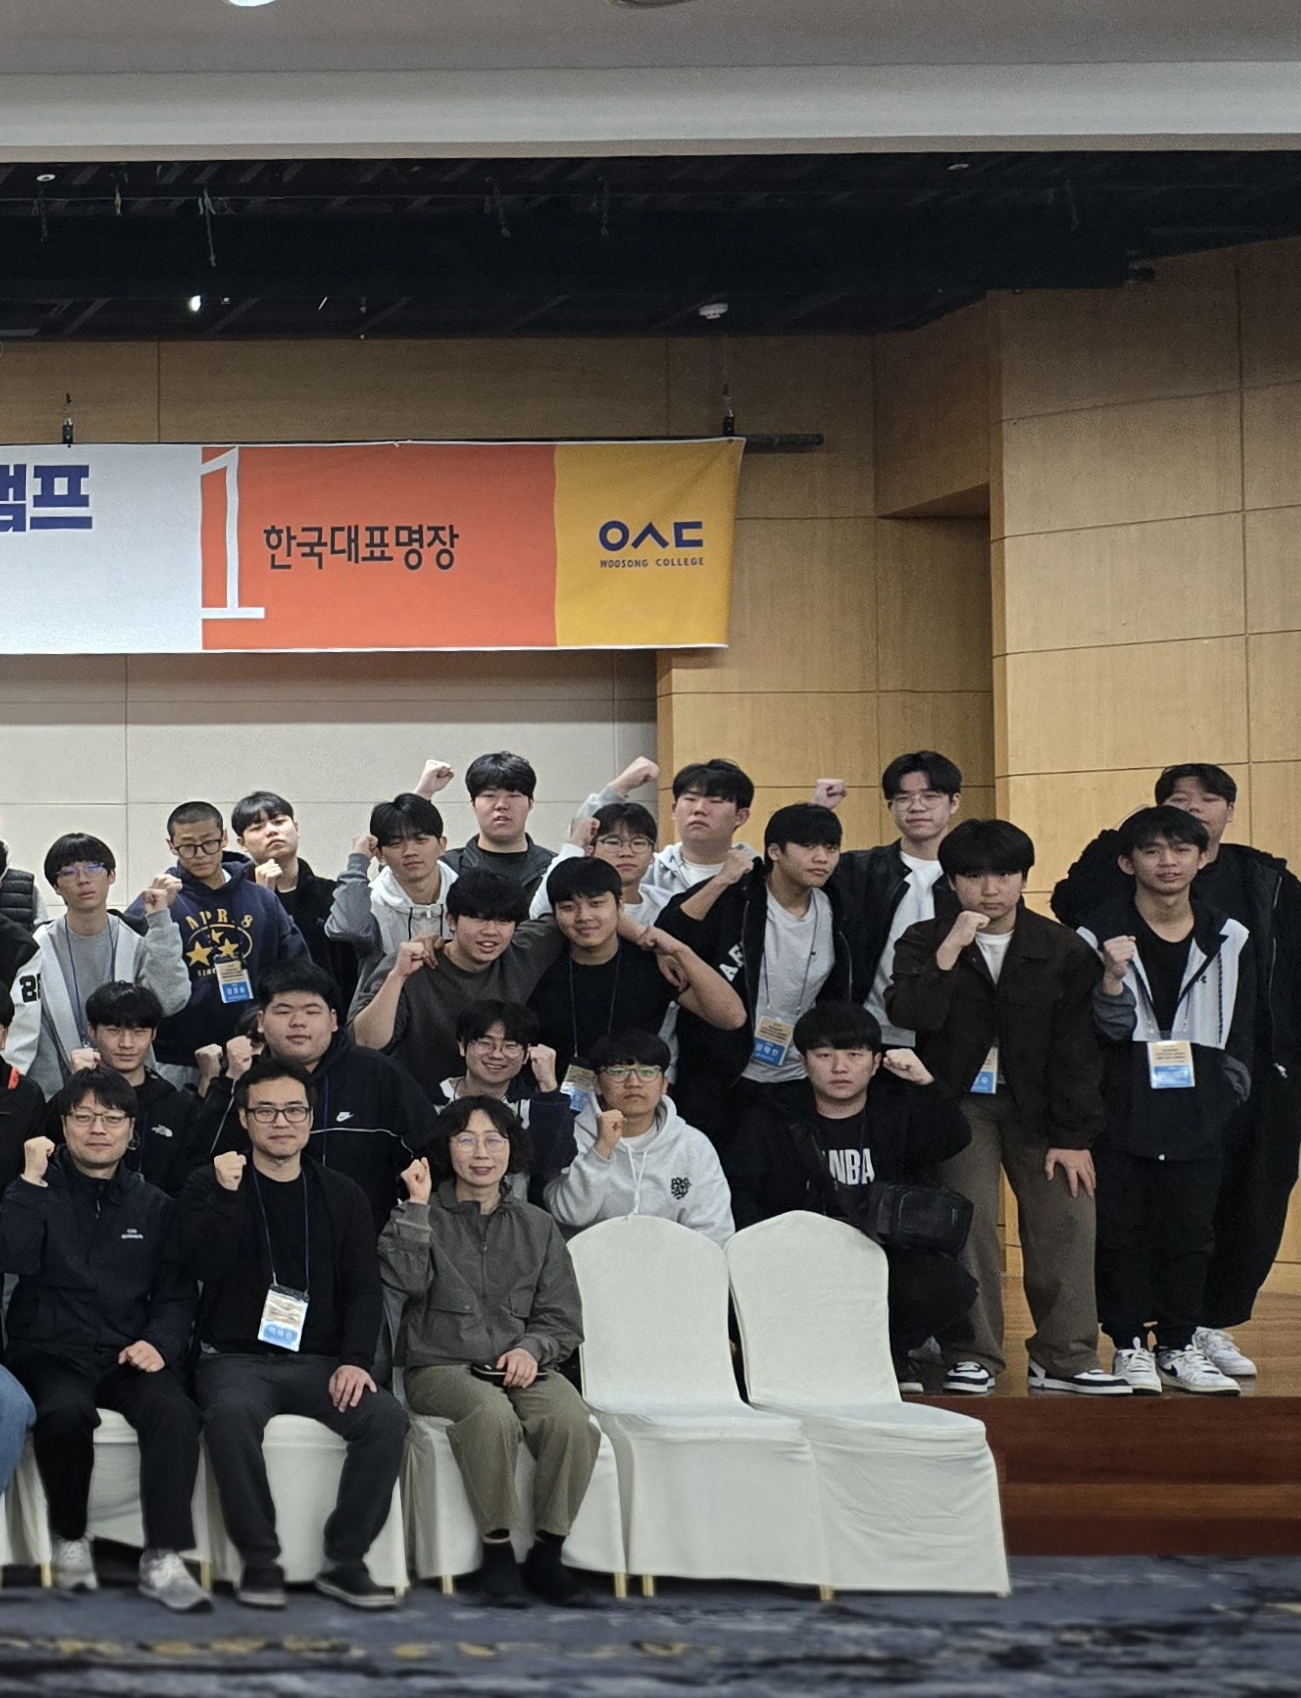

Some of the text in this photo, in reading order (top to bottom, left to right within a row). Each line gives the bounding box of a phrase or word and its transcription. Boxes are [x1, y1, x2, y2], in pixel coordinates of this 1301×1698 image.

[263, 523, 460, 571] 한국대표명장
[600, 557, 705, 568] WOOSONG COLLEGE
[829, 1148, 875, 1185] NBA
